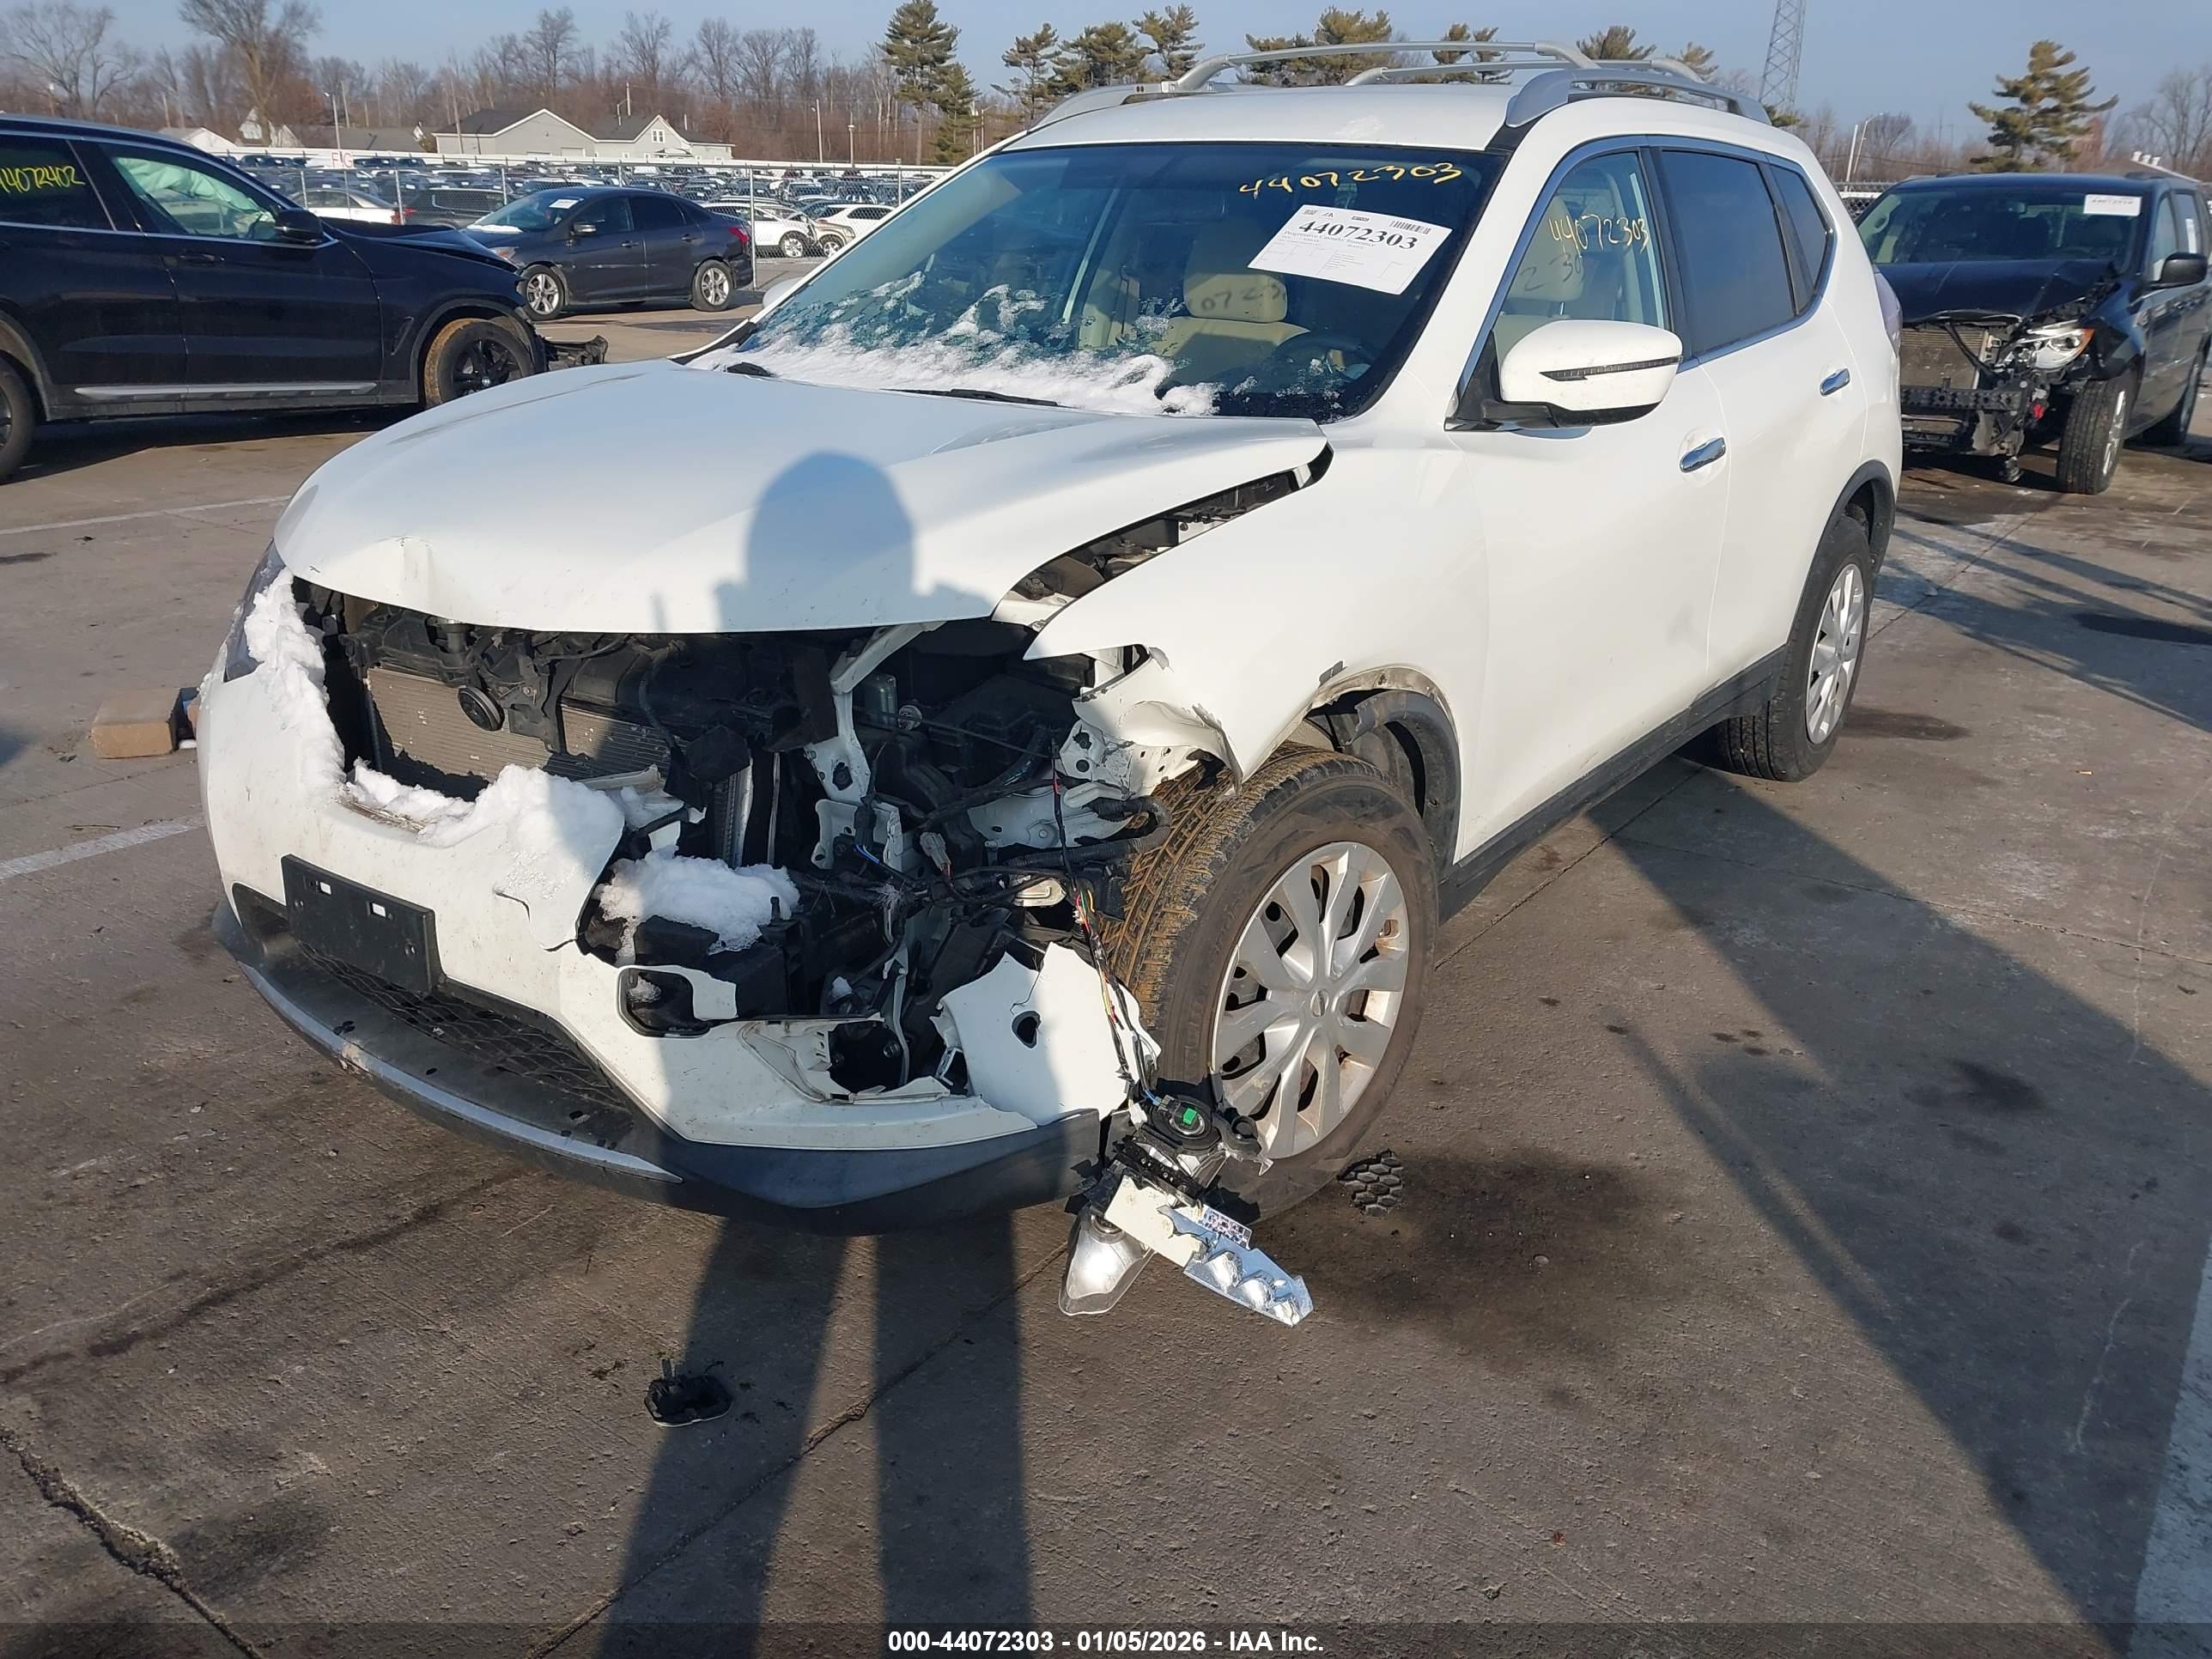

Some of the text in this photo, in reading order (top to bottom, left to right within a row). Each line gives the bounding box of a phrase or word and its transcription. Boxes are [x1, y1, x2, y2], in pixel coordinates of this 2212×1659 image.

[1239, 162, 1462, 199] 44072303
[1298, 220, 1419, 250] 44072303
[1548, 214, 1650, 258] 44072303
